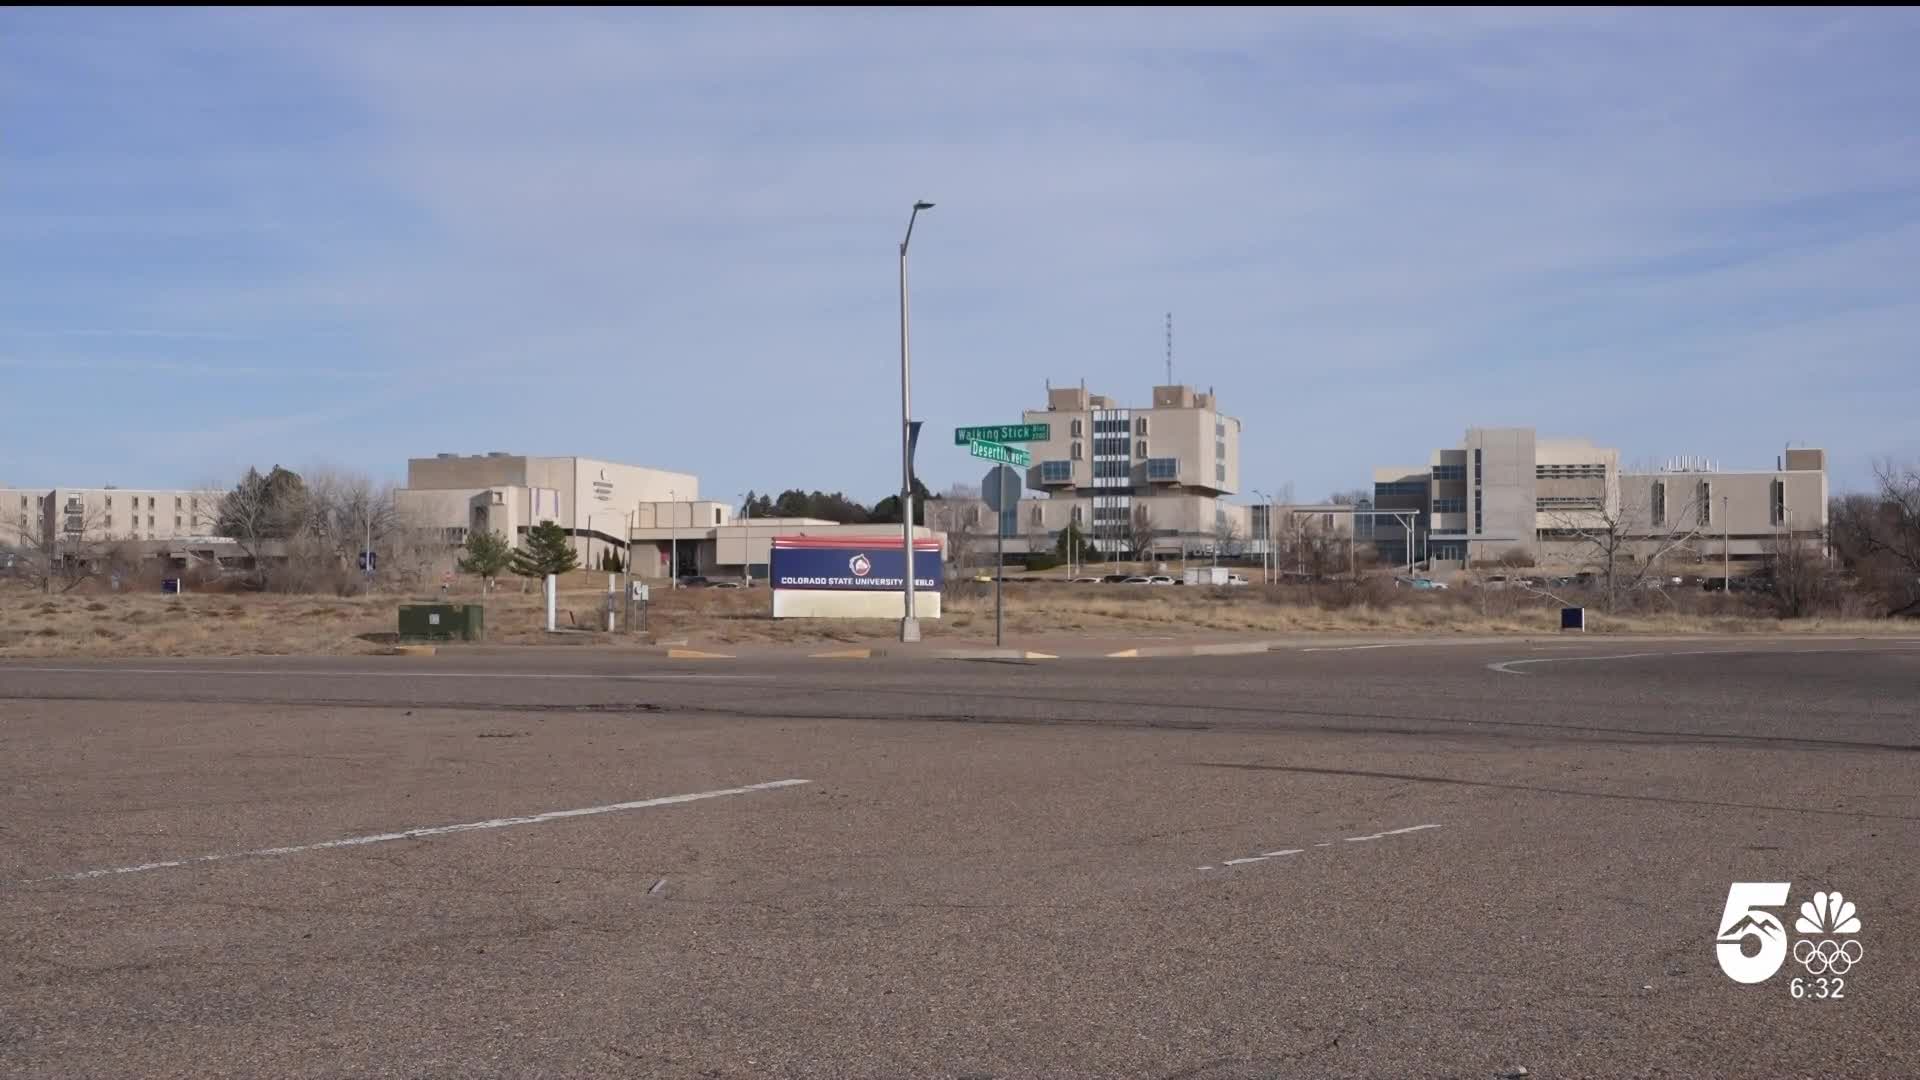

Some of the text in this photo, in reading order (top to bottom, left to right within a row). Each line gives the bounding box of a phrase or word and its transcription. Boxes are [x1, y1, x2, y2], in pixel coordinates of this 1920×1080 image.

[958, 429, 999, 442] Walking
[1001, 426, 1030, 440] Stick
[781, 576, 826, 585] COLORADO
[828, 577, 853, 585] STATE
[855, 578, 903, 586] UNIVERSITY
